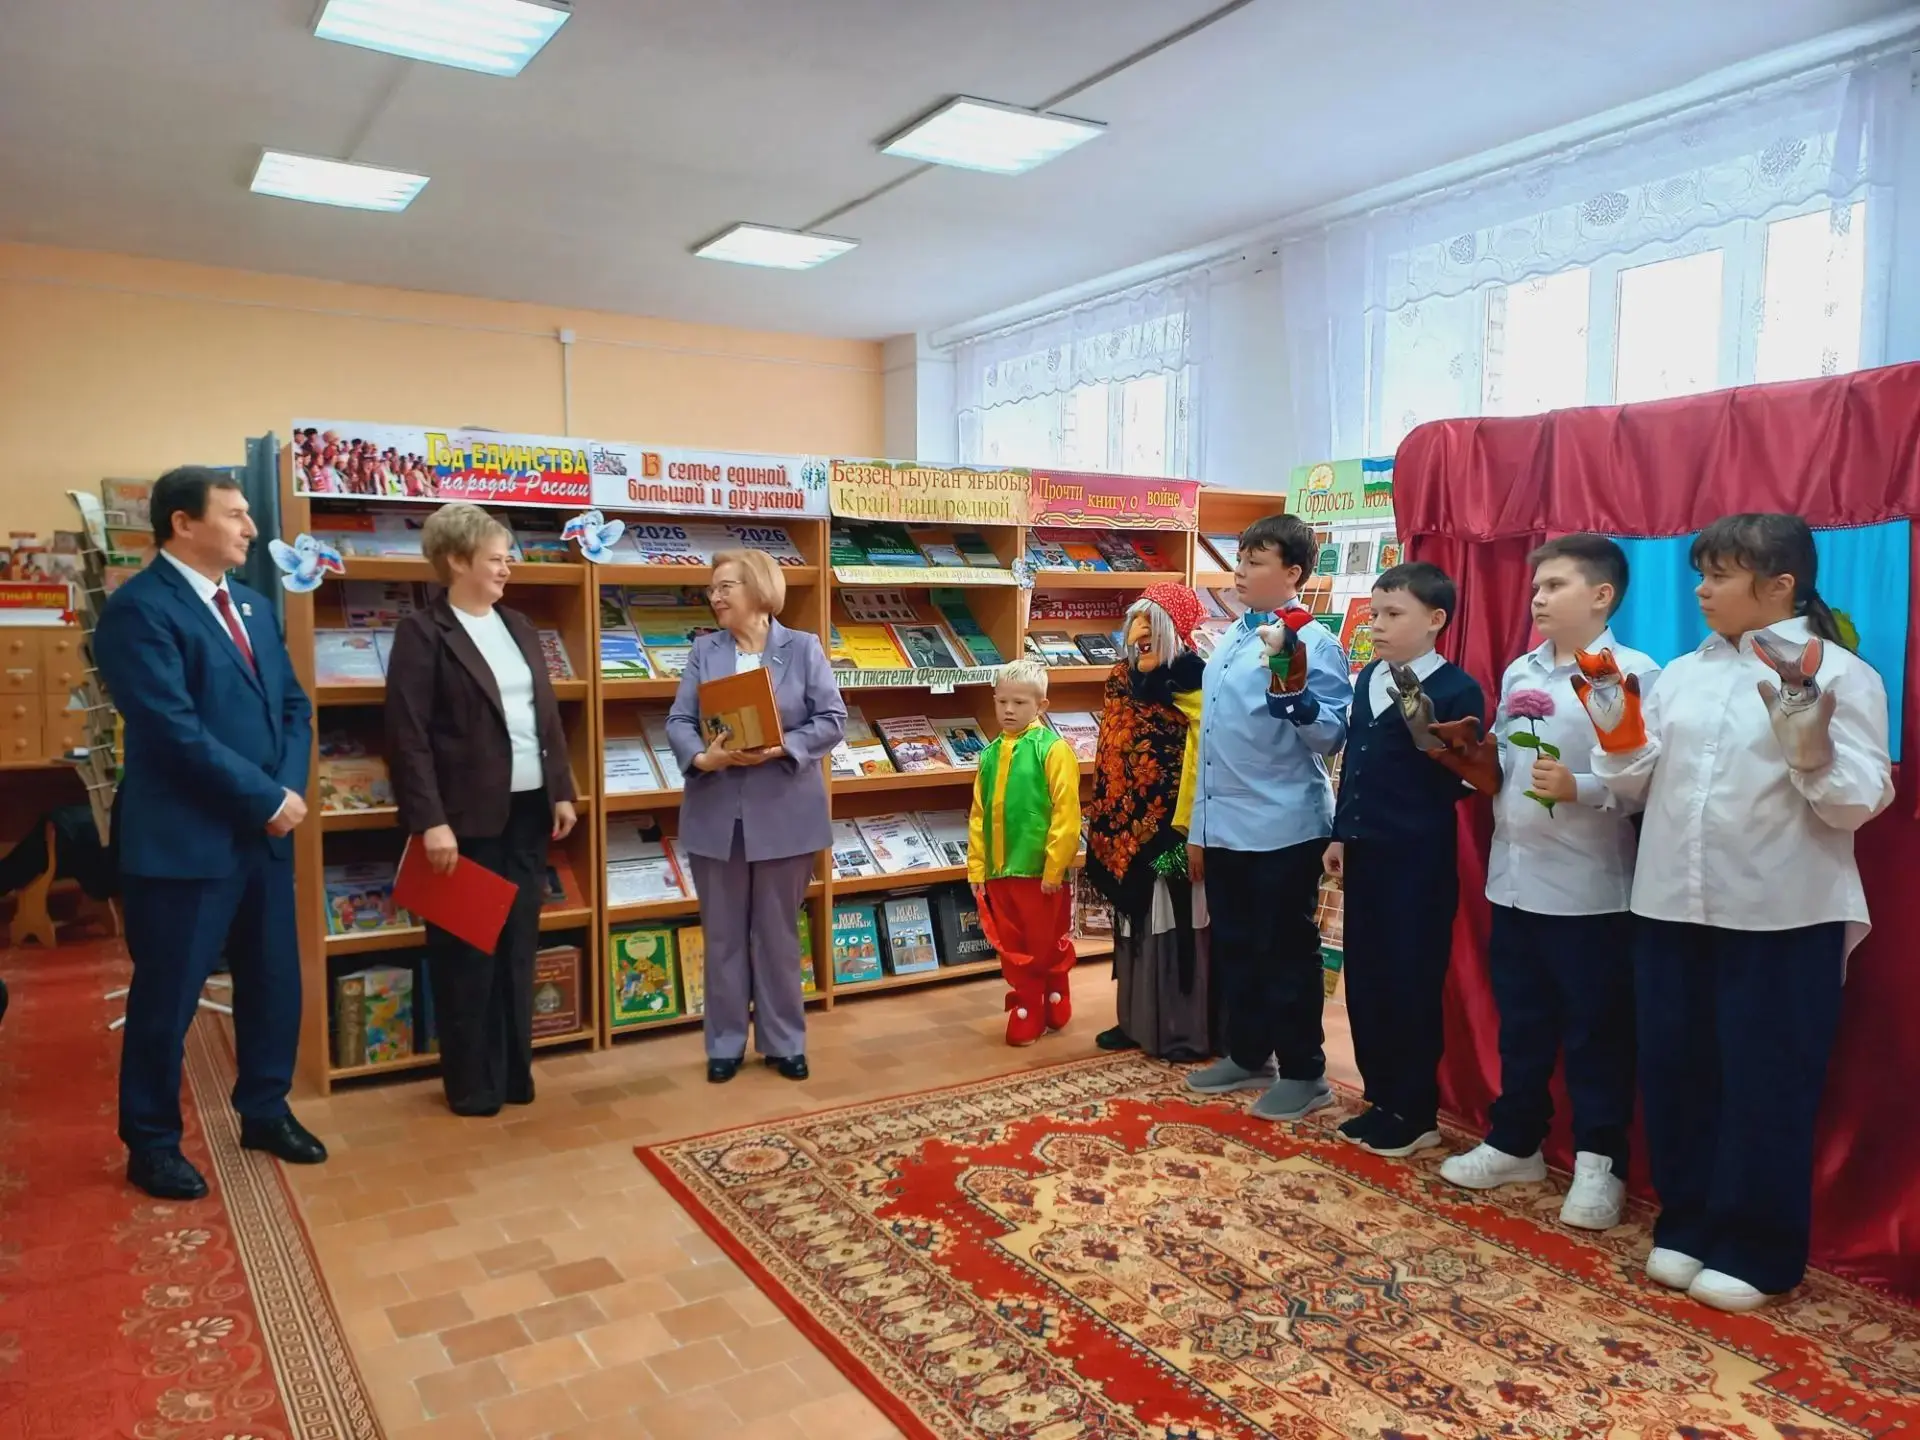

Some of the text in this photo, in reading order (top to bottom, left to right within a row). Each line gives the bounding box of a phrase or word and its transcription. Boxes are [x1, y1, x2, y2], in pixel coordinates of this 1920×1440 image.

[424, 432, 590, 475] Год ЕДИНСТВА
[641, 451, 792, 487] В семье единой,
[440, 470, 589, 499] народов России
[628, 479, 804, 510] большой и дружной
[1039, 477, 1180, 511] Прочти книгу о войне
[840, 488, 891, 513] Край
[945, 496, 1009, 519] родной
[1296, 488, 1354, 519] Гордость
[633, 525, 687, 540] 2026
[736, 527, 786, 542] 2026
[1031, 610, 1042, 619] Я
[1052, 601, 1063, 609] Я
[855, 671, 861, 686] и
[863, 669, 915, 686] писатели
[917, 667, 991, 692] Федоровского
